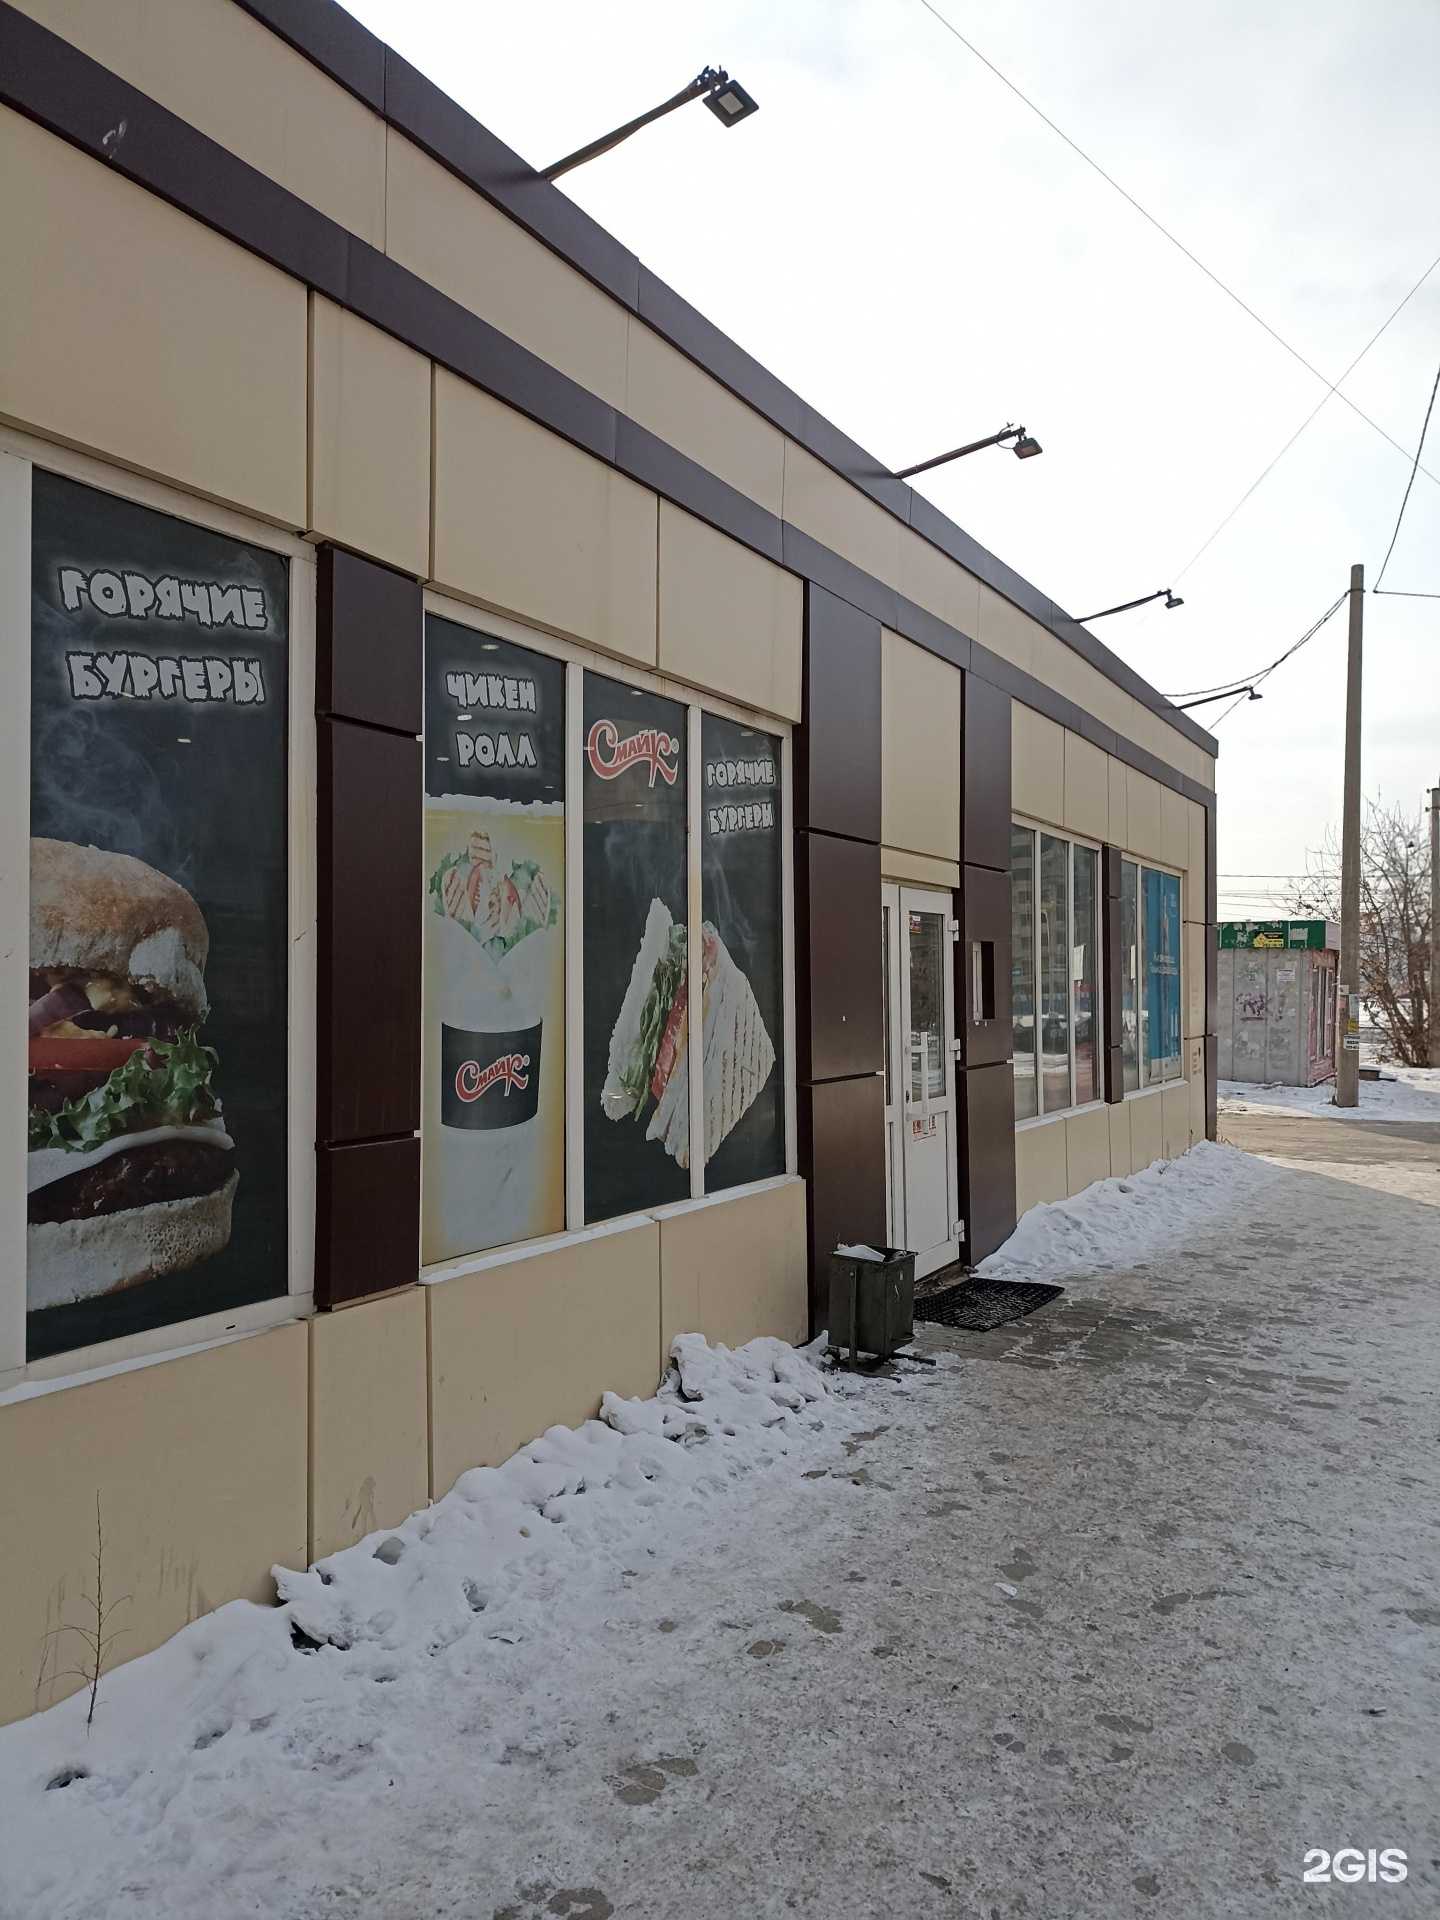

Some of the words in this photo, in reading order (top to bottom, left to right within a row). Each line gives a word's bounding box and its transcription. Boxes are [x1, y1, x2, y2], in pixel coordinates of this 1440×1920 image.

[60, 568, 268, 629] ГОРЯЧИЕ
[66, 651, 266, 704] БУРГЕРЫ
[445, 671, 537, 712] ЧИКЕН
[456, 731, 538, 768] РОЛЛ
[706, 758, 776, 789] ГОРЯЧИЕ
[708, 802, 775, 835] БУРГЕРЫ
